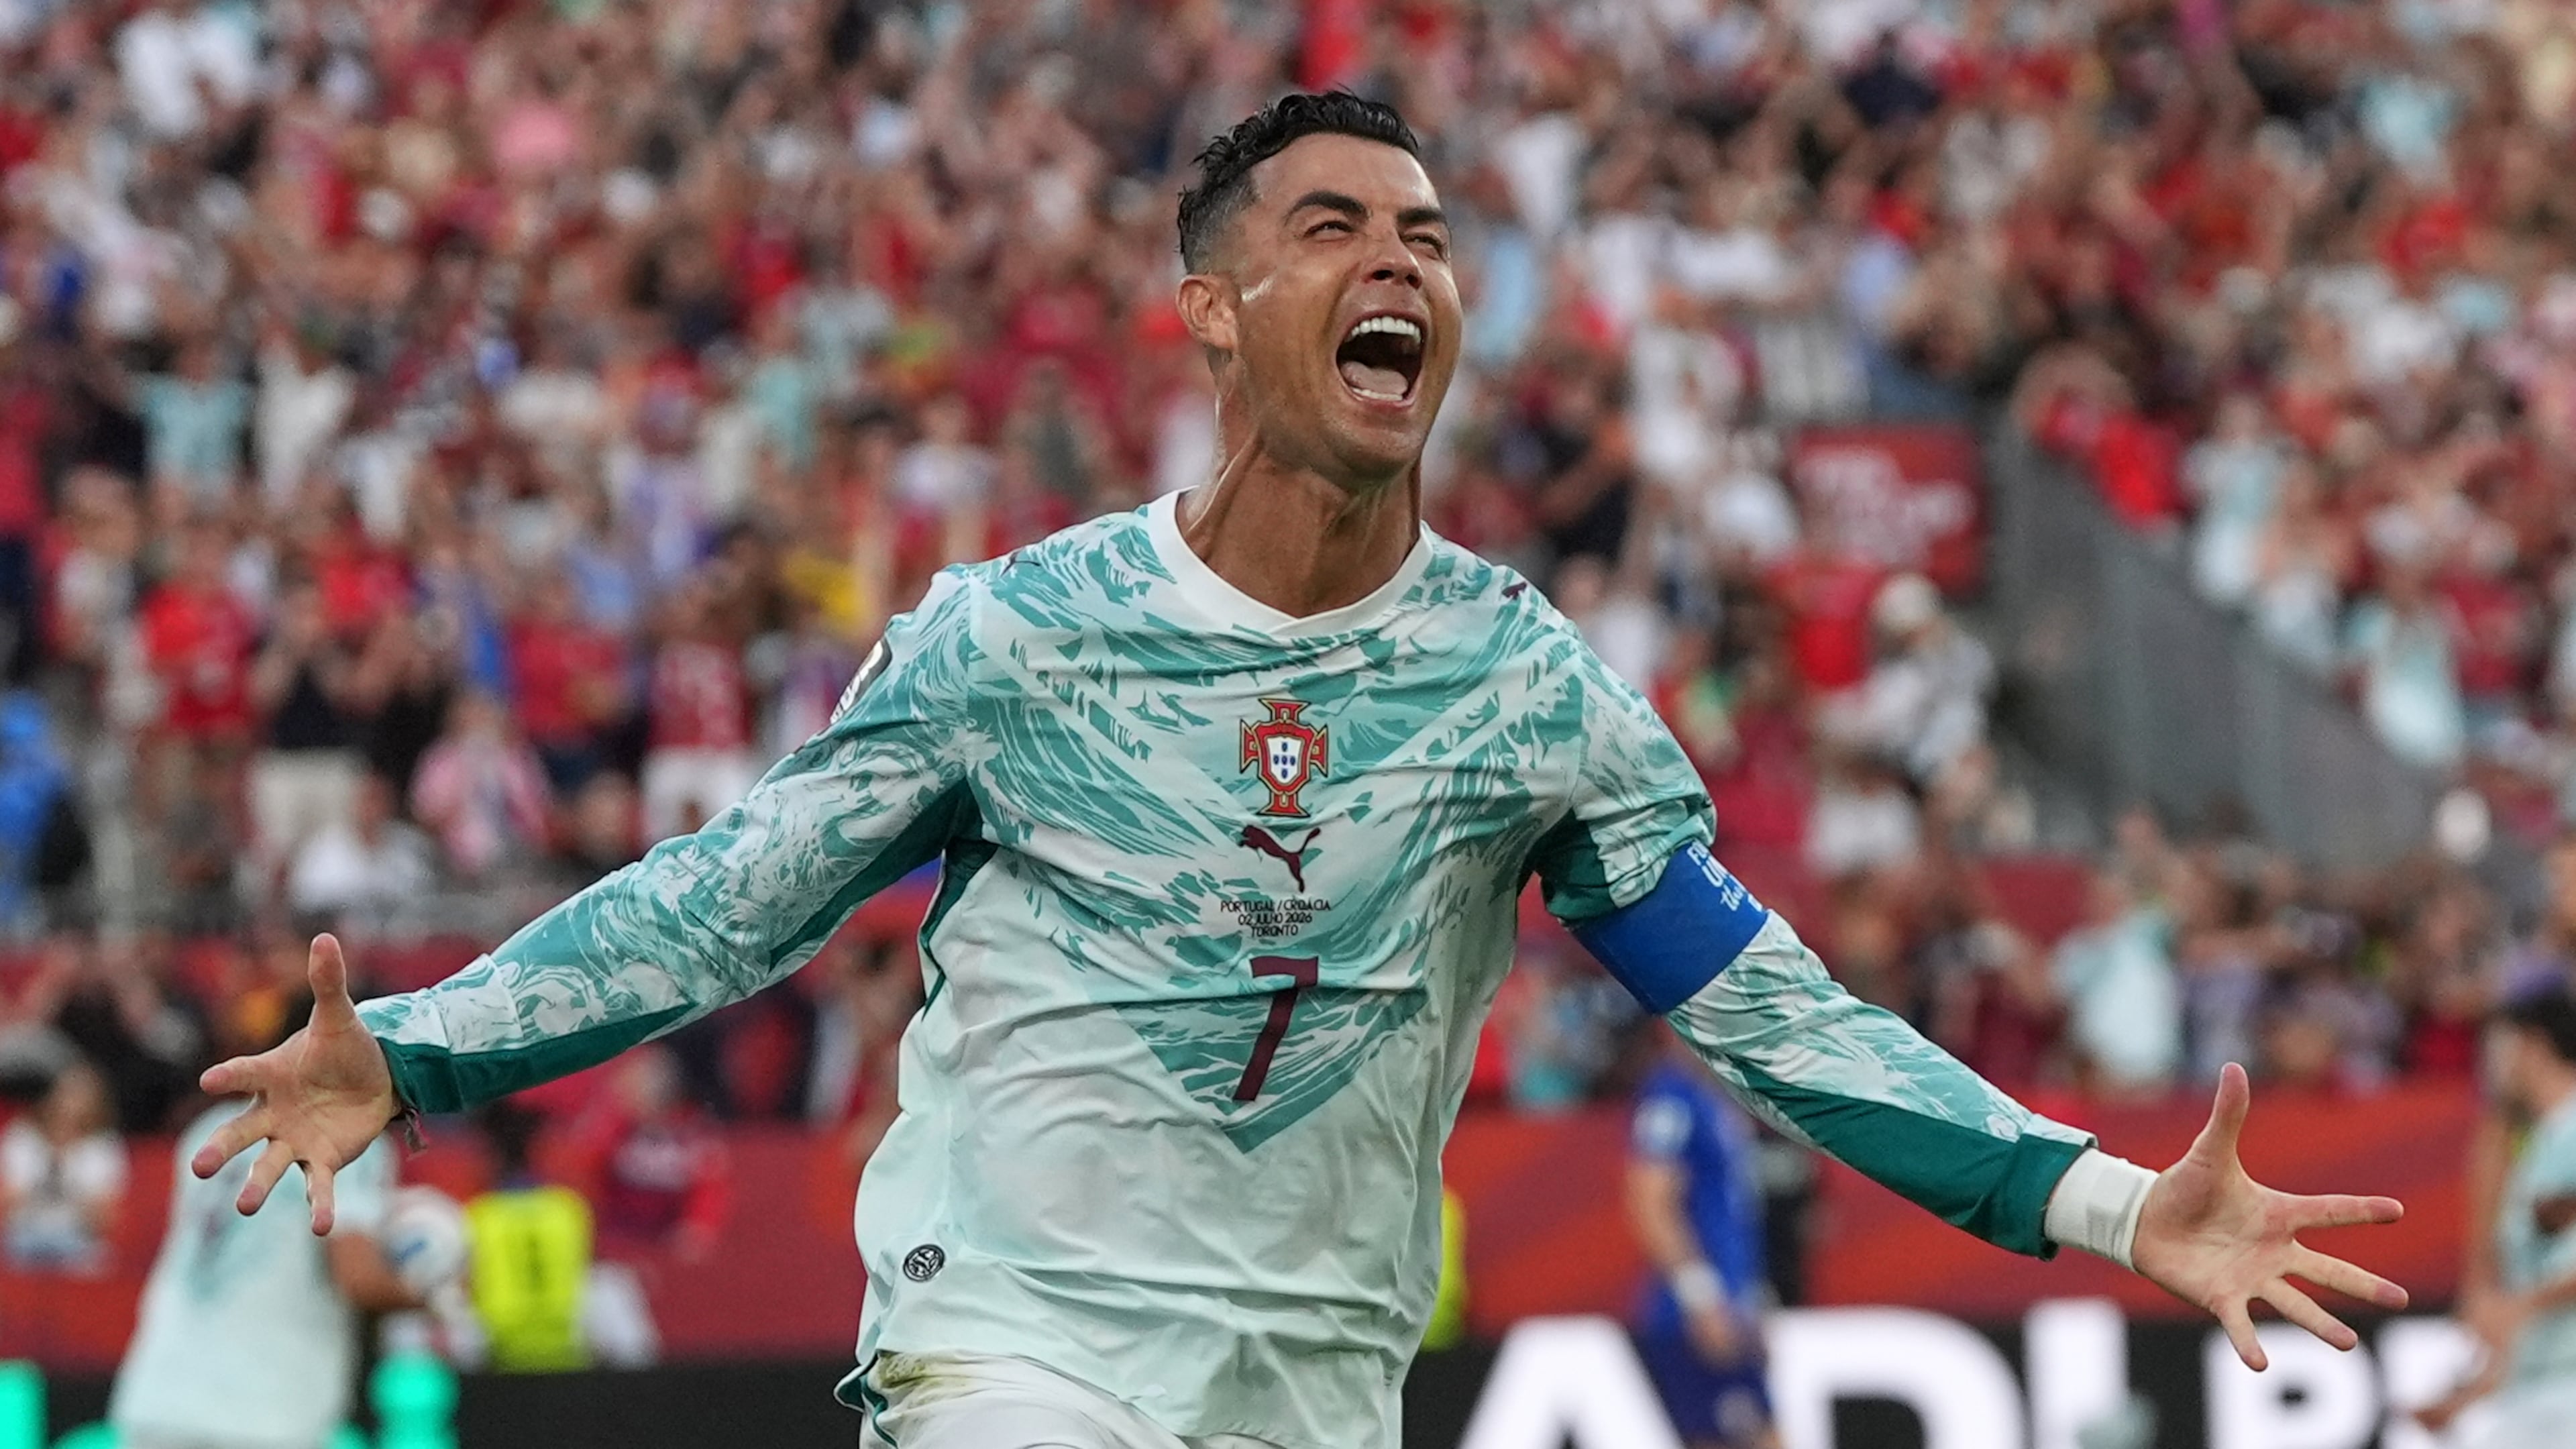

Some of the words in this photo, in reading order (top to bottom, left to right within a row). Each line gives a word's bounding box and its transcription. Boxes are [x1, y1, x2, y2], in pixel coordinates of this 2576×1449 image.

[1220, 900, 1275, 912] PORTUGAL
[1238, 914, 1252, 926] 02
[1254, 912, 1283, 925] JULHO
[1285, 912, 1313, 924] 2026
[1251, 924, 1299, 938] TORONTO
[1232, 955, 1319, 1101] 7
